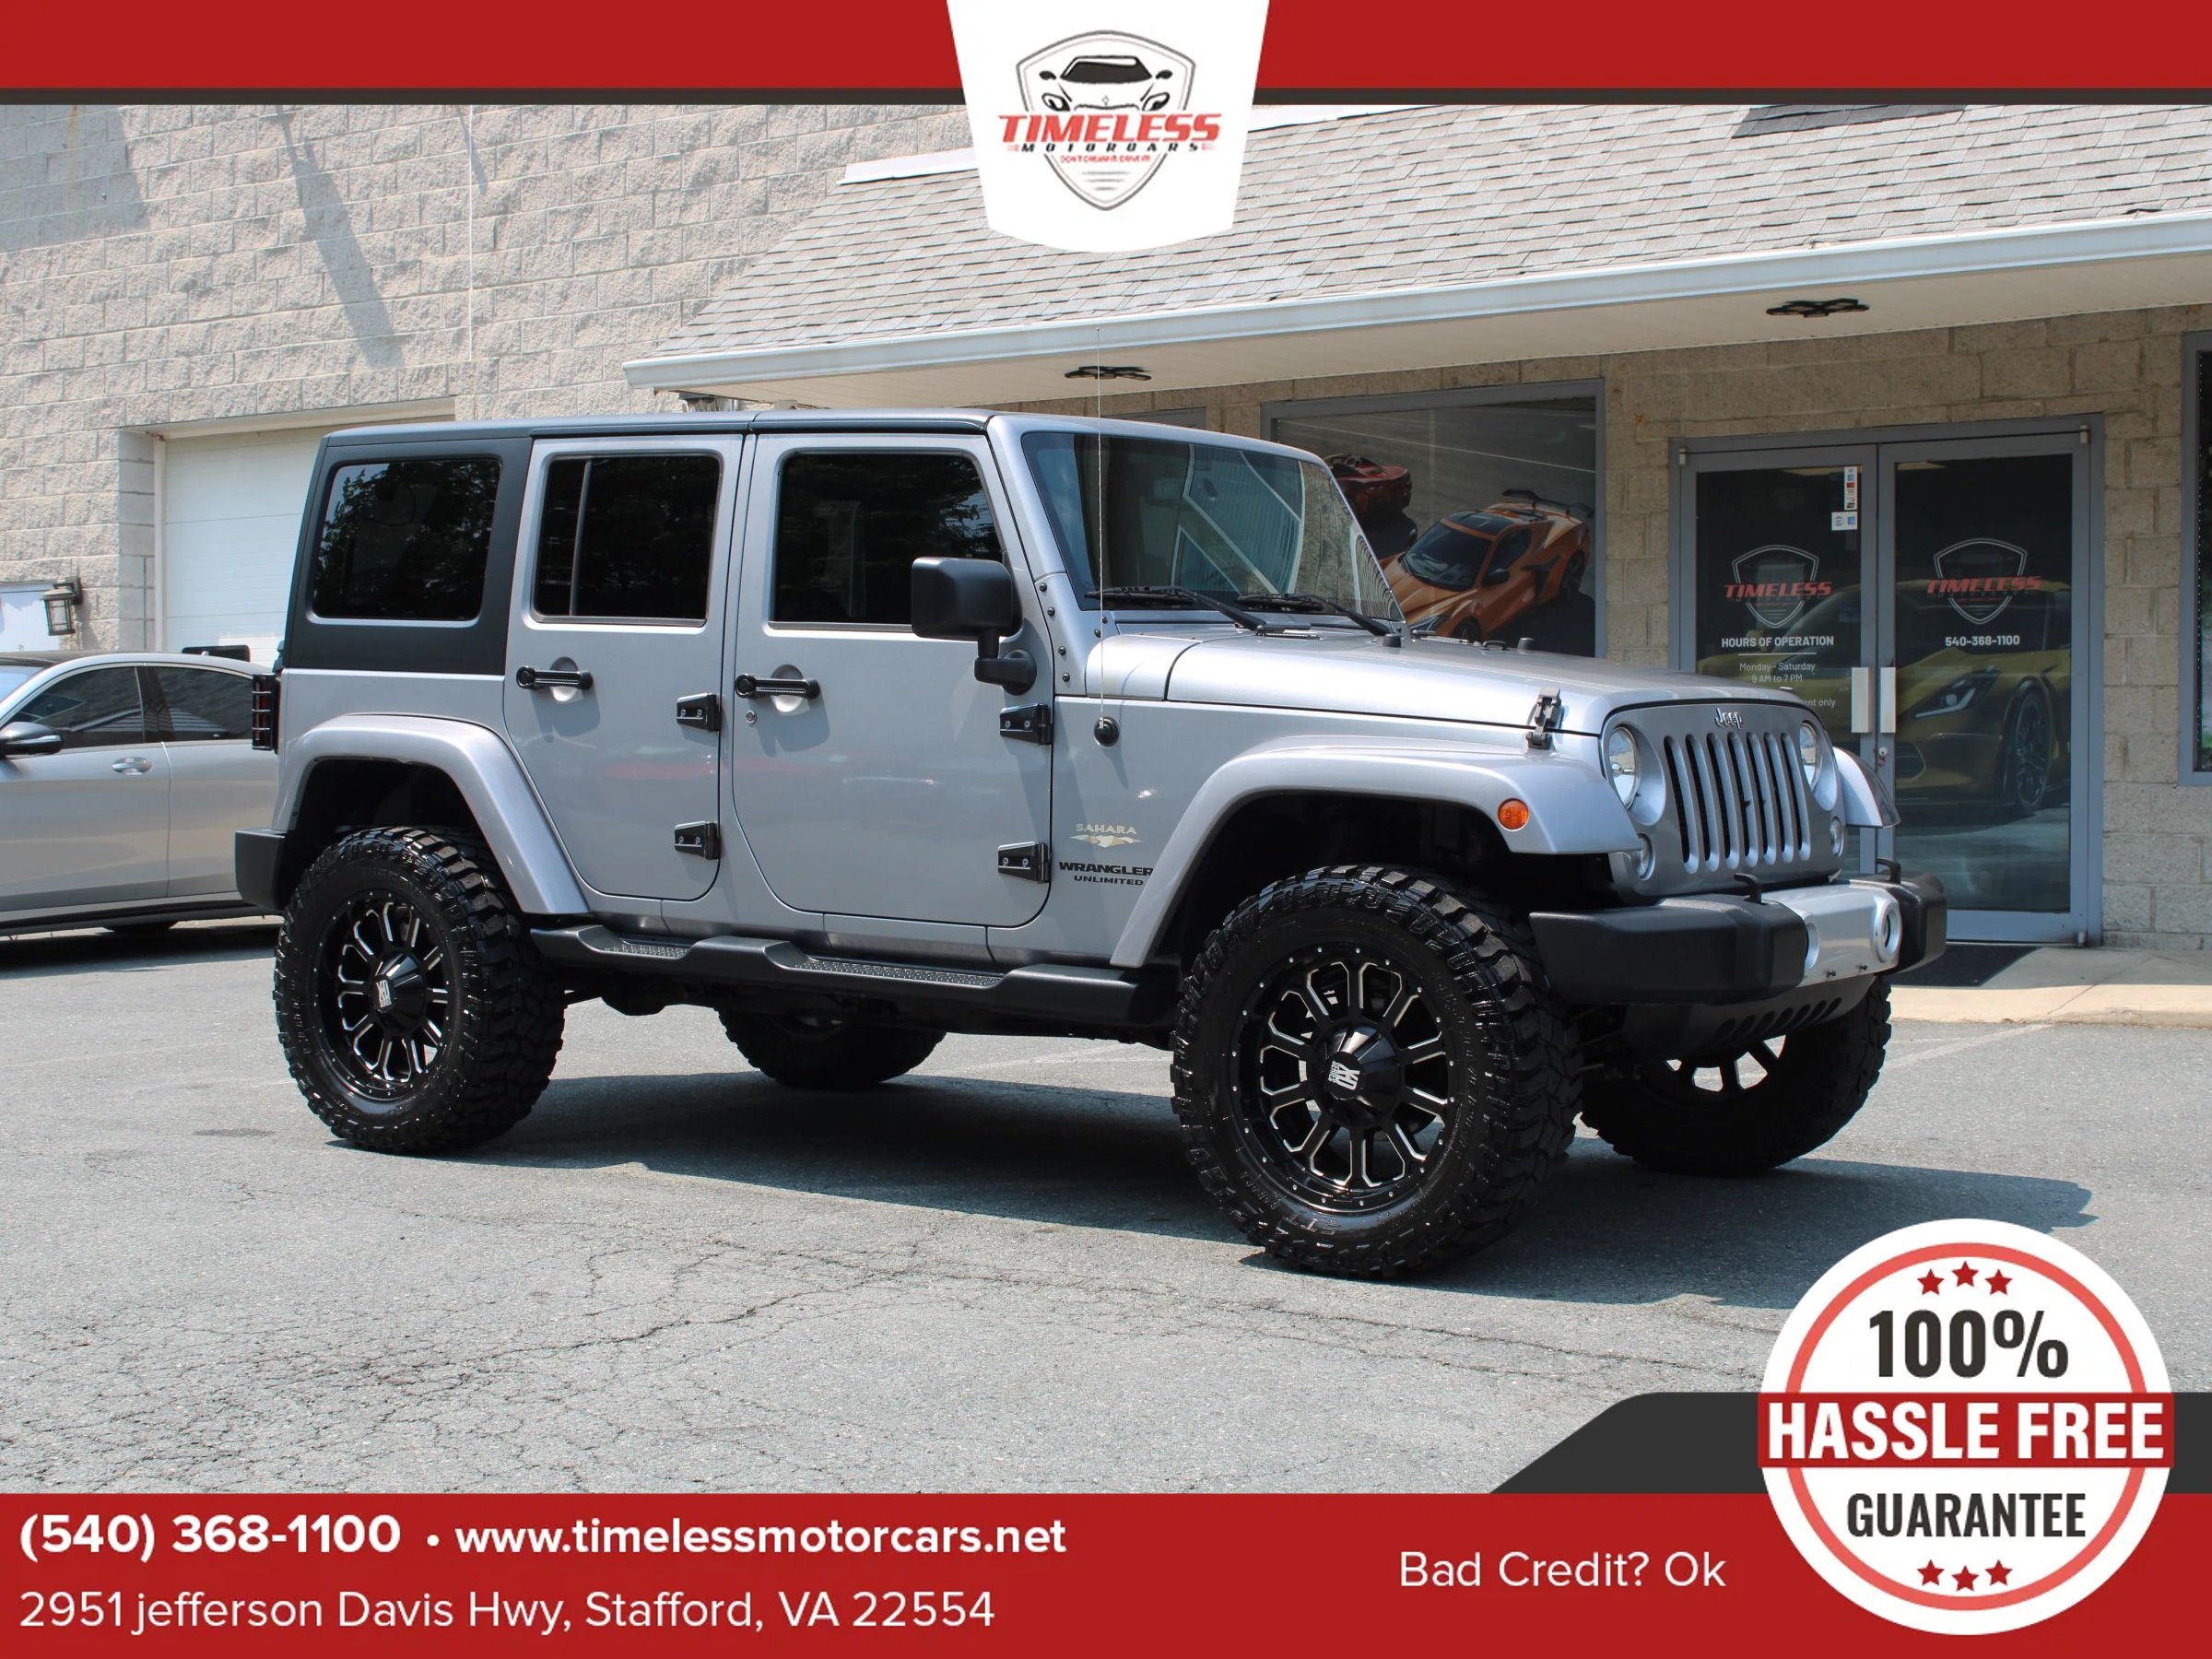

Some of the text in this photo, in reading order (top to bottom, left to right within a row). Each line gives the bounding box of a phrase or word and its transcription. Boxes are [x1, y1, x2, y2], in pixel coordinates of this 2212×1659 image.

[1724, 582, 1833, 598] TIMELESS
[1926, 576, 2041, 594] TIMELESS
[1722, 635, 1834, 648] HOURS OF OPERATION
[1945, 635, 2020, 646] 540-368-1100
[1739, 663, 1771, 673] Monday
[1778, 662, 1816, 672] Saturday
[1752, 674, 1803, 683] 9 AM to 7 PM
[1819, 698, 1836, 708] only
[1714, 707, 1743, 730] Jeep
[1076, 823, 1137, 835] SAHARA
[1074, 875, 1144, 886] UNLIMITED
